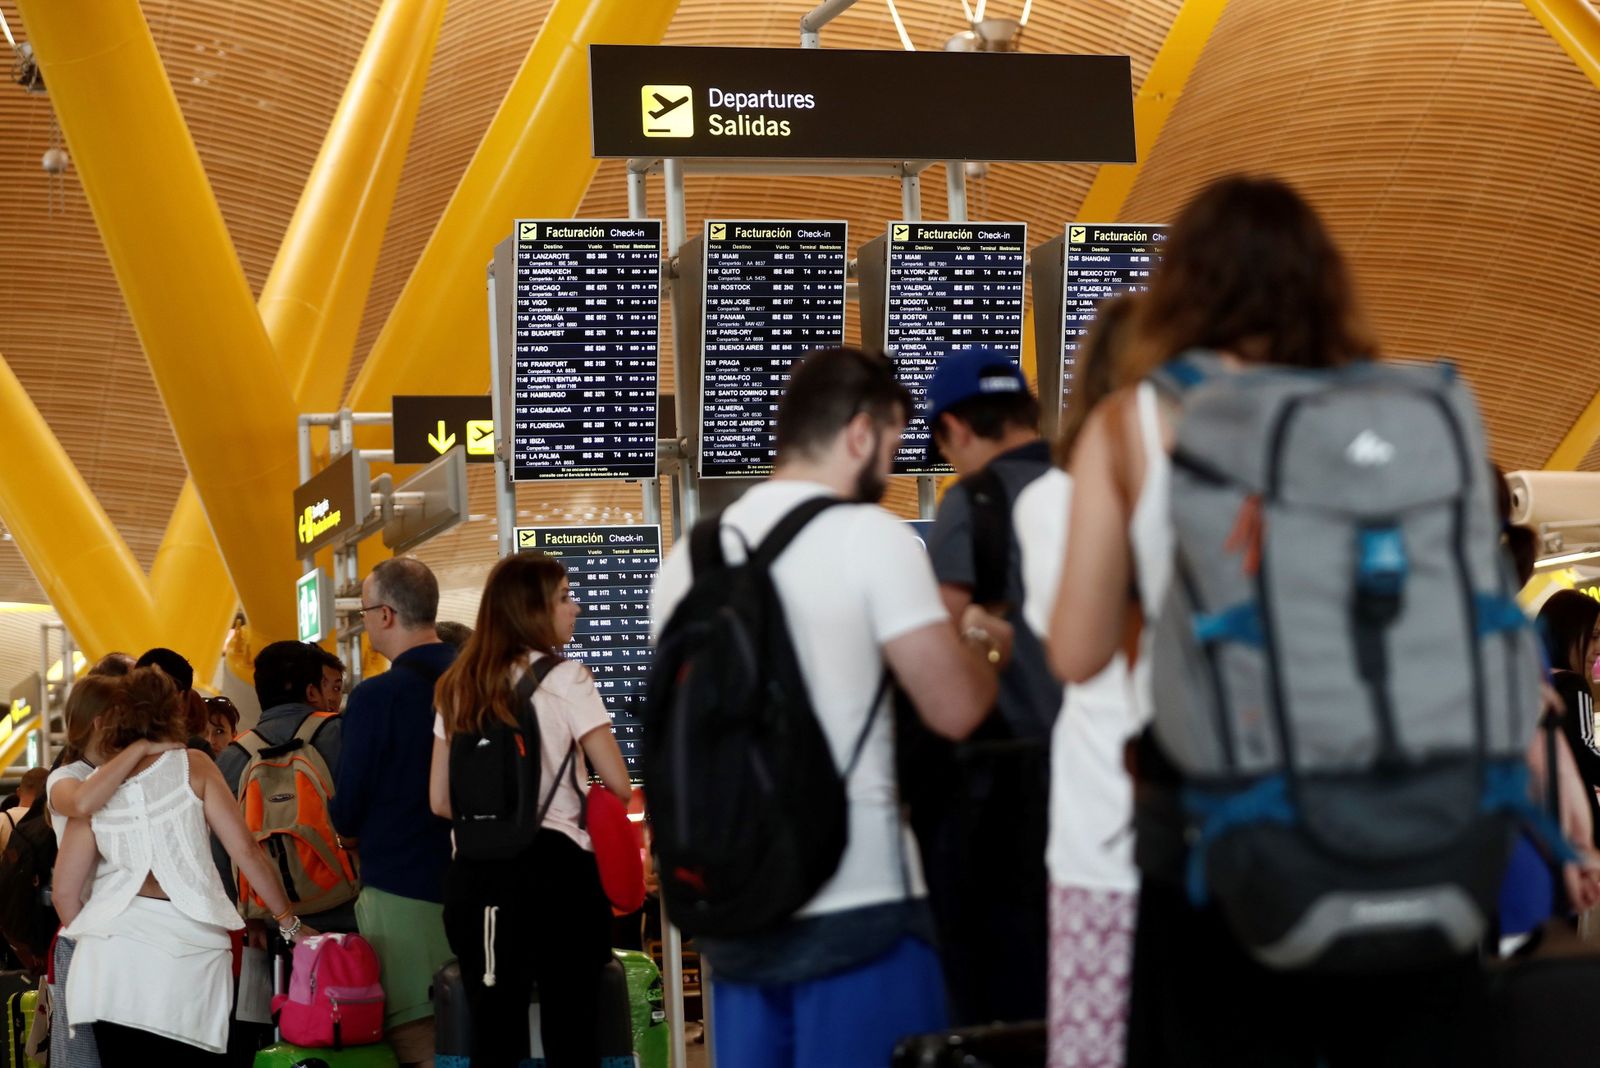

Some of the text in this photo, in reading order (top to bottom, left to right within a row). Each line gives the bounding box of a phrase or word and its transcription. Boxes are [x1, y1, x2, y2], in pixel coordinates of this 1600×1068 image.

[709, 88, 814, 112] Departures
[709, 114, 790, 136] Salidas
[546, 227, 604, 237] Facturación
[736, 228, 791, 238] Facturación
[918, 229, 972, 239] Facturación
[1094, 231, 1147, 241] Facturación
[546, 533, 603, 544] Facturación
